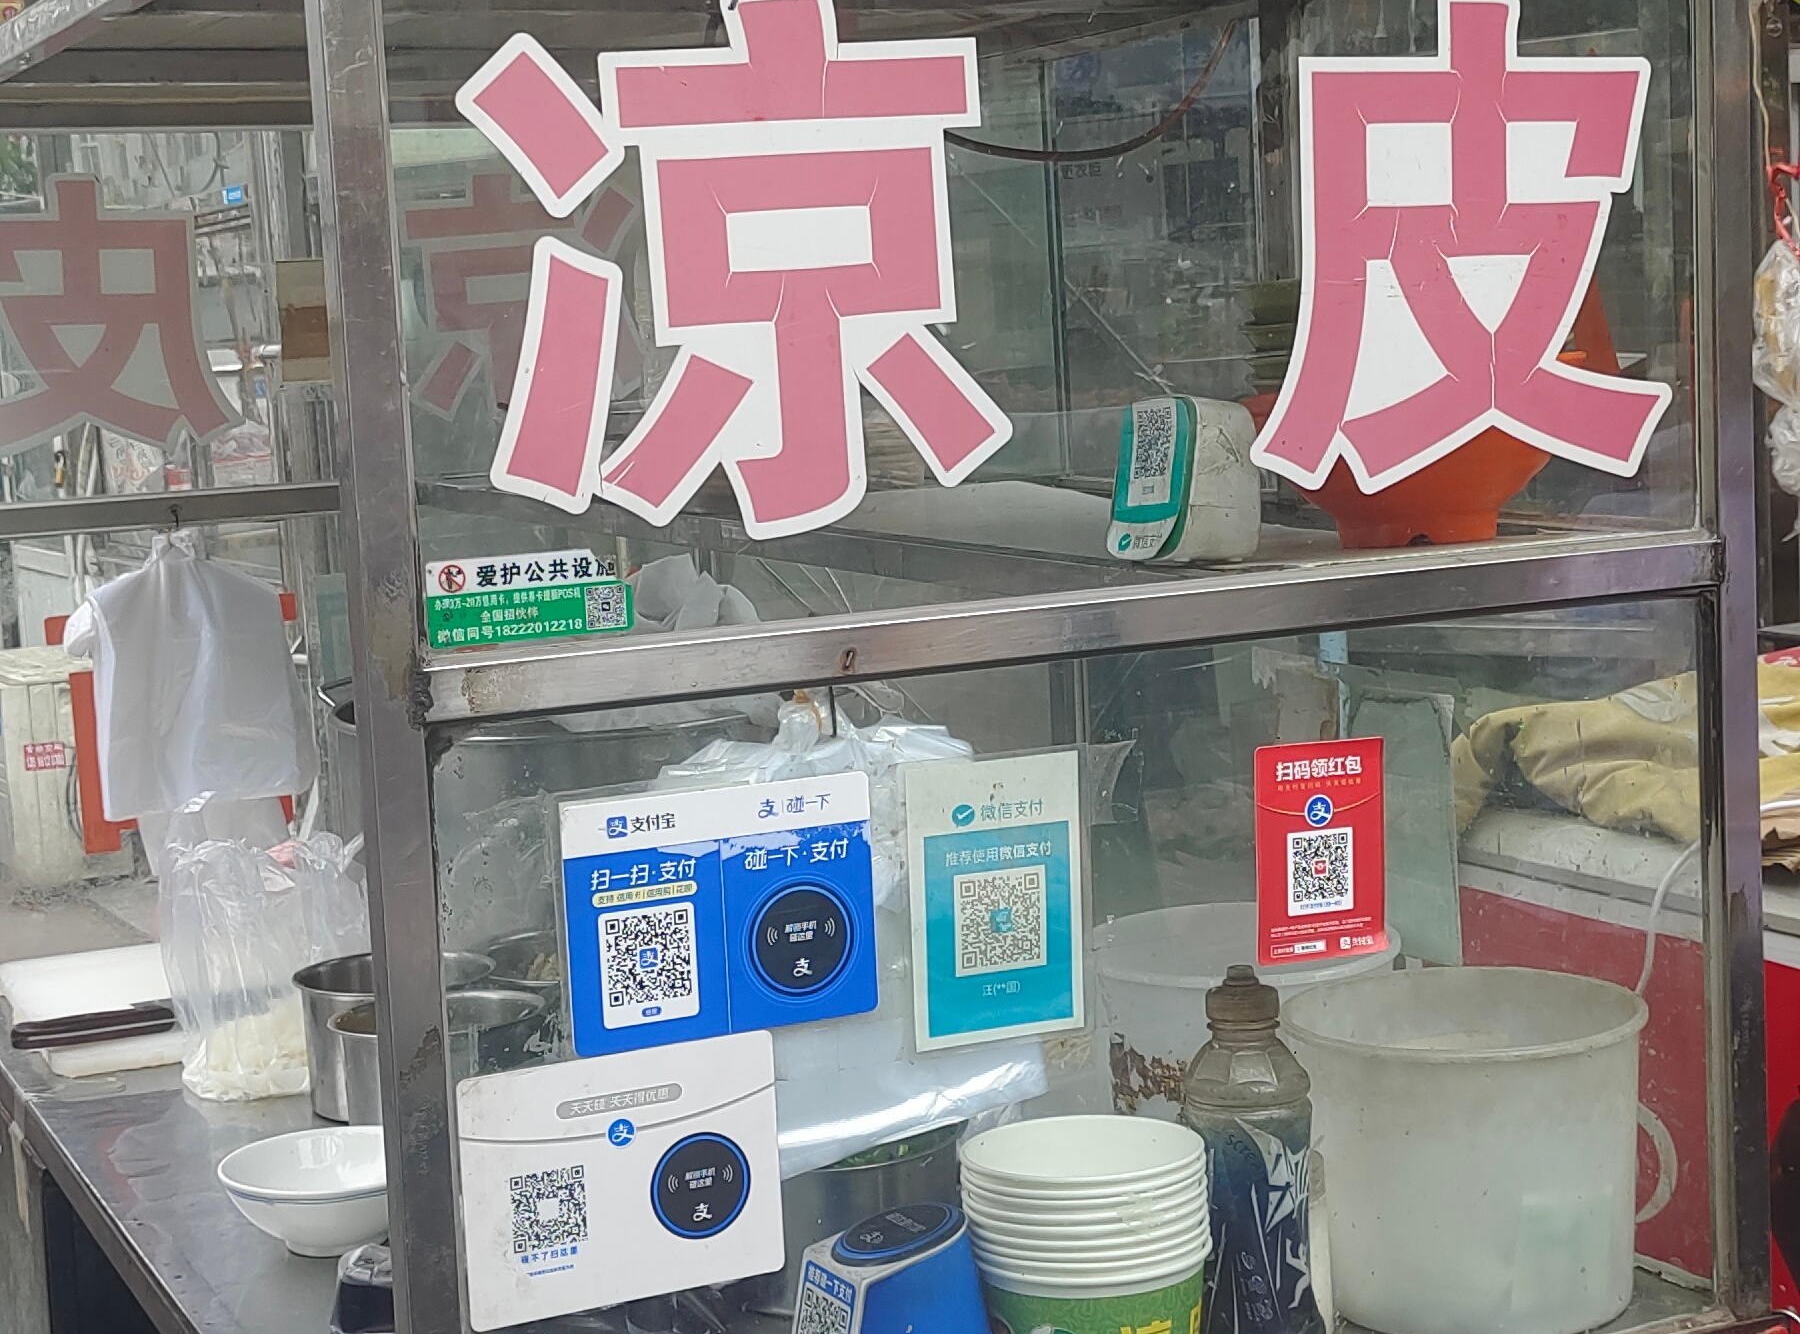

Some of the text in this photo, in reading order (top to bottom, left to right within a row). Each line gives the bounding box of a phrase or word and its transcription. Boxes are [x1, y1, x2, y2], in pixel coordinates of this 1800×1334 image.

[476, 557, 616, 587] 爱护公共设施
[1276, 756, 1362, 782] 扫码领红包
[630, 813, 676, 833] 支付宝
[980, 798, 1043, 822] 微信支付
[945, 840, 1053, 867] 推荐使用微信支付
